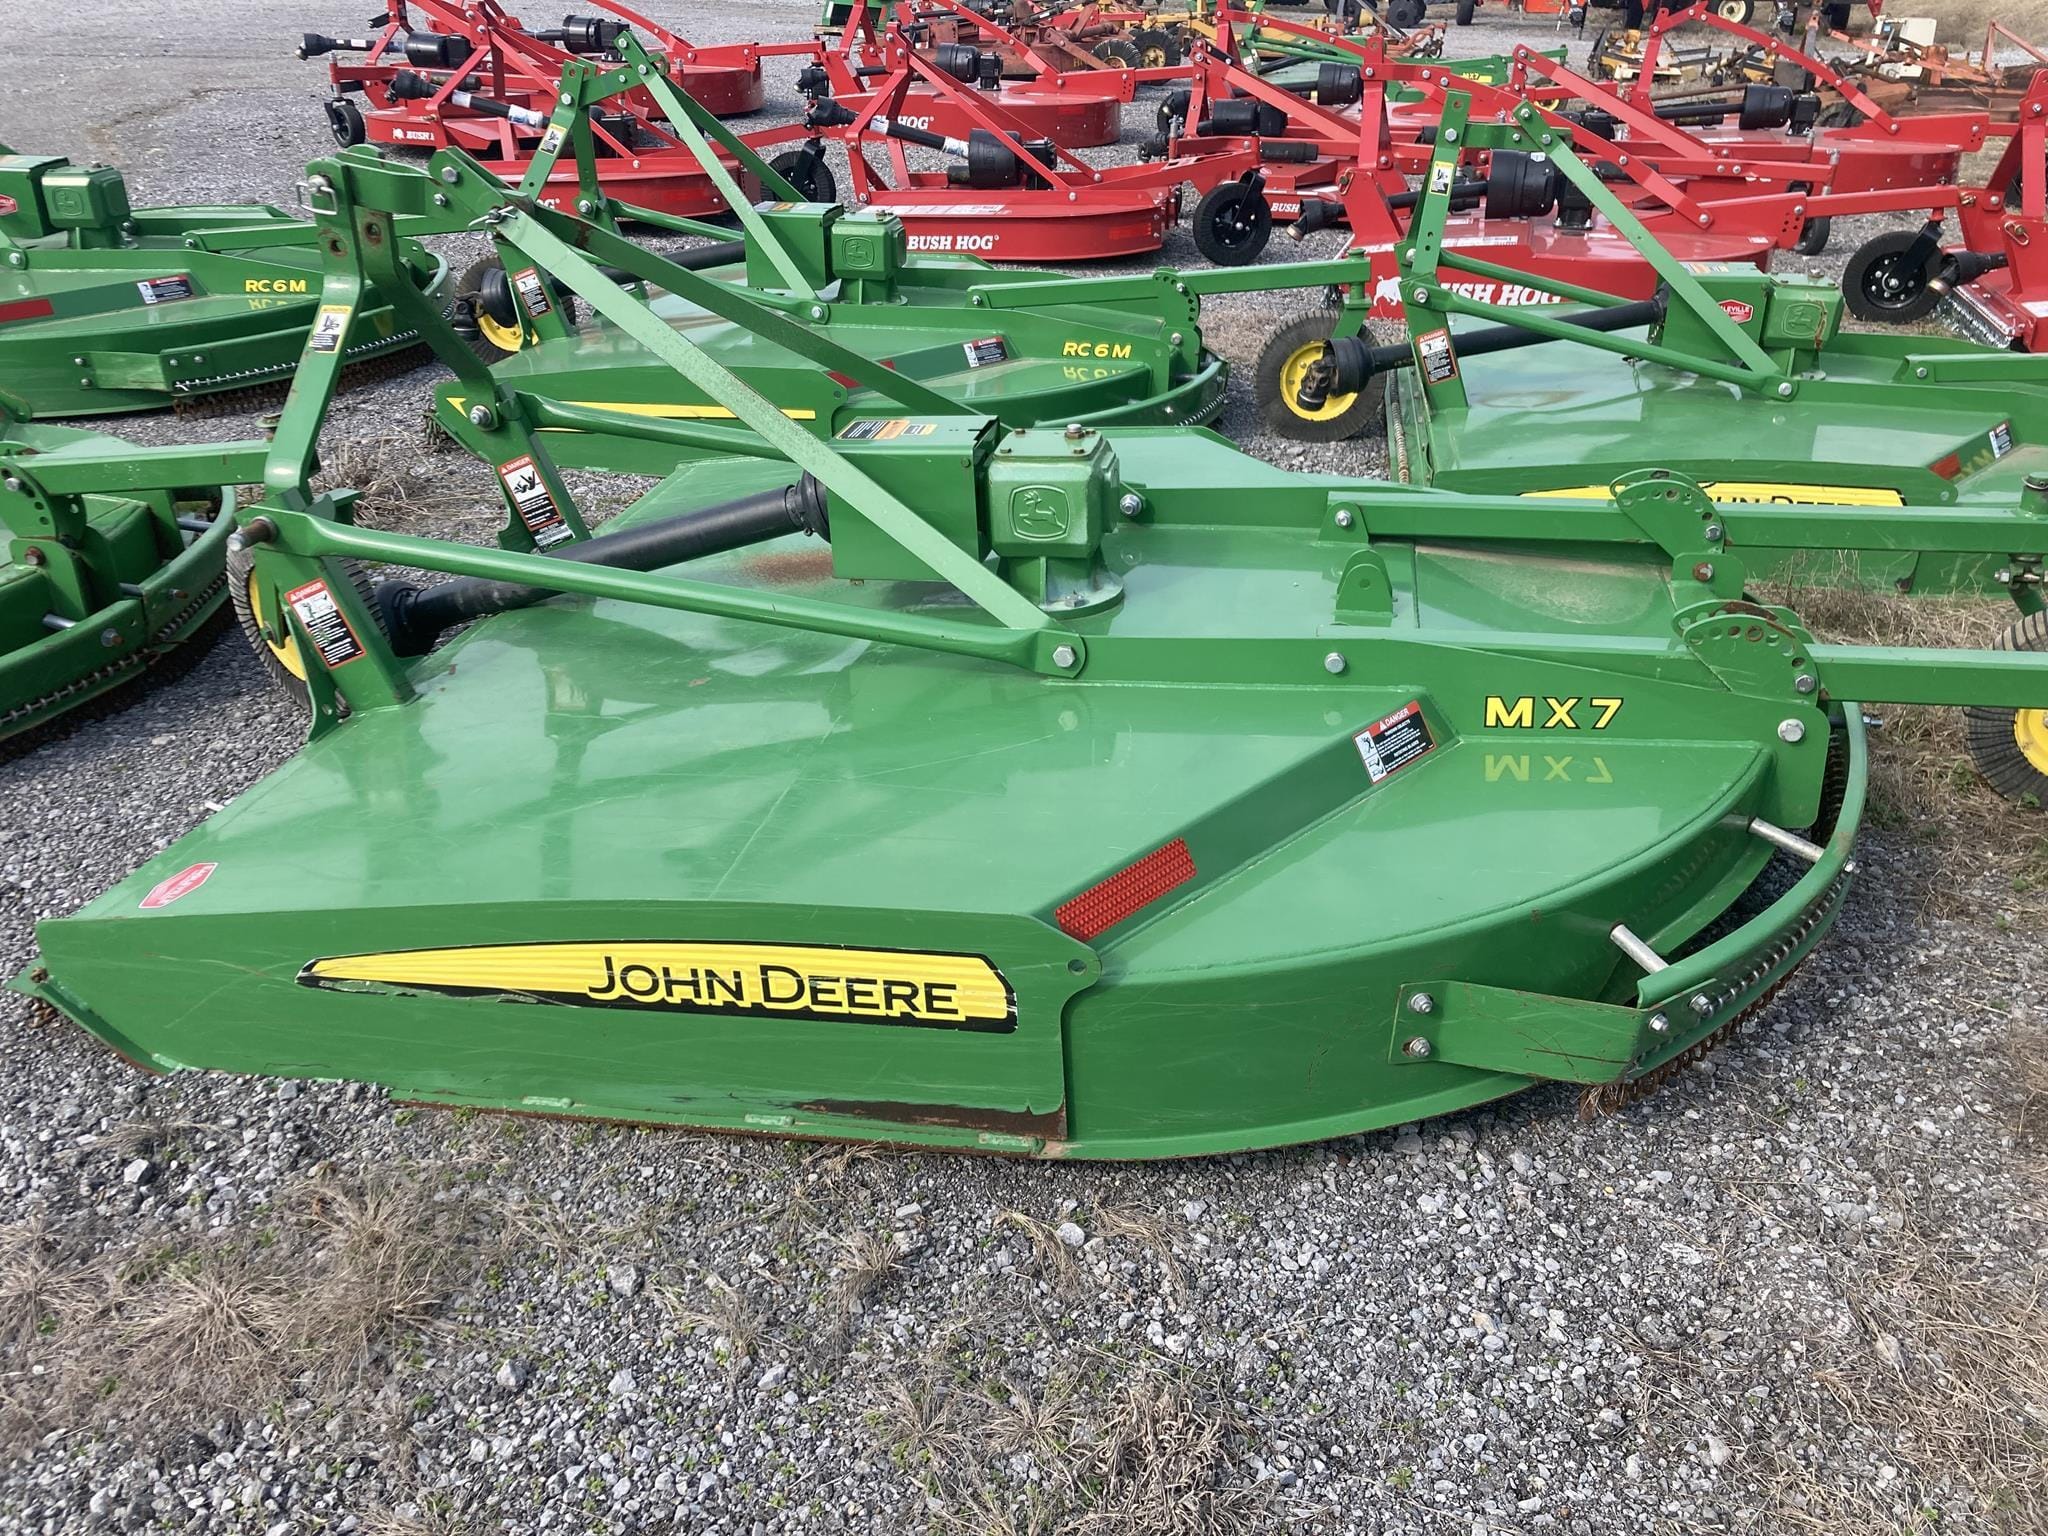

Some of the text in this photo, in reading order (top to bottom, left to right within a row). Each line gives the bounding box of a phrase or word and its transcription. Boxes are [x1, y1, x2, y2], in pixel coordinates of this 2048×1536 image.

[1270, 203, 1300, 213] BUSH
[907, 235, 952, 250] BUSH
[245, 279, 307, 293] RC6M
[1062, 341, 1132, 359] RC6M
[1384, 707, 1410, 728] DANGER
[1484, 696, 1624, 730] MX7
[588, 955, 960, 1016] JOHN DEERE
